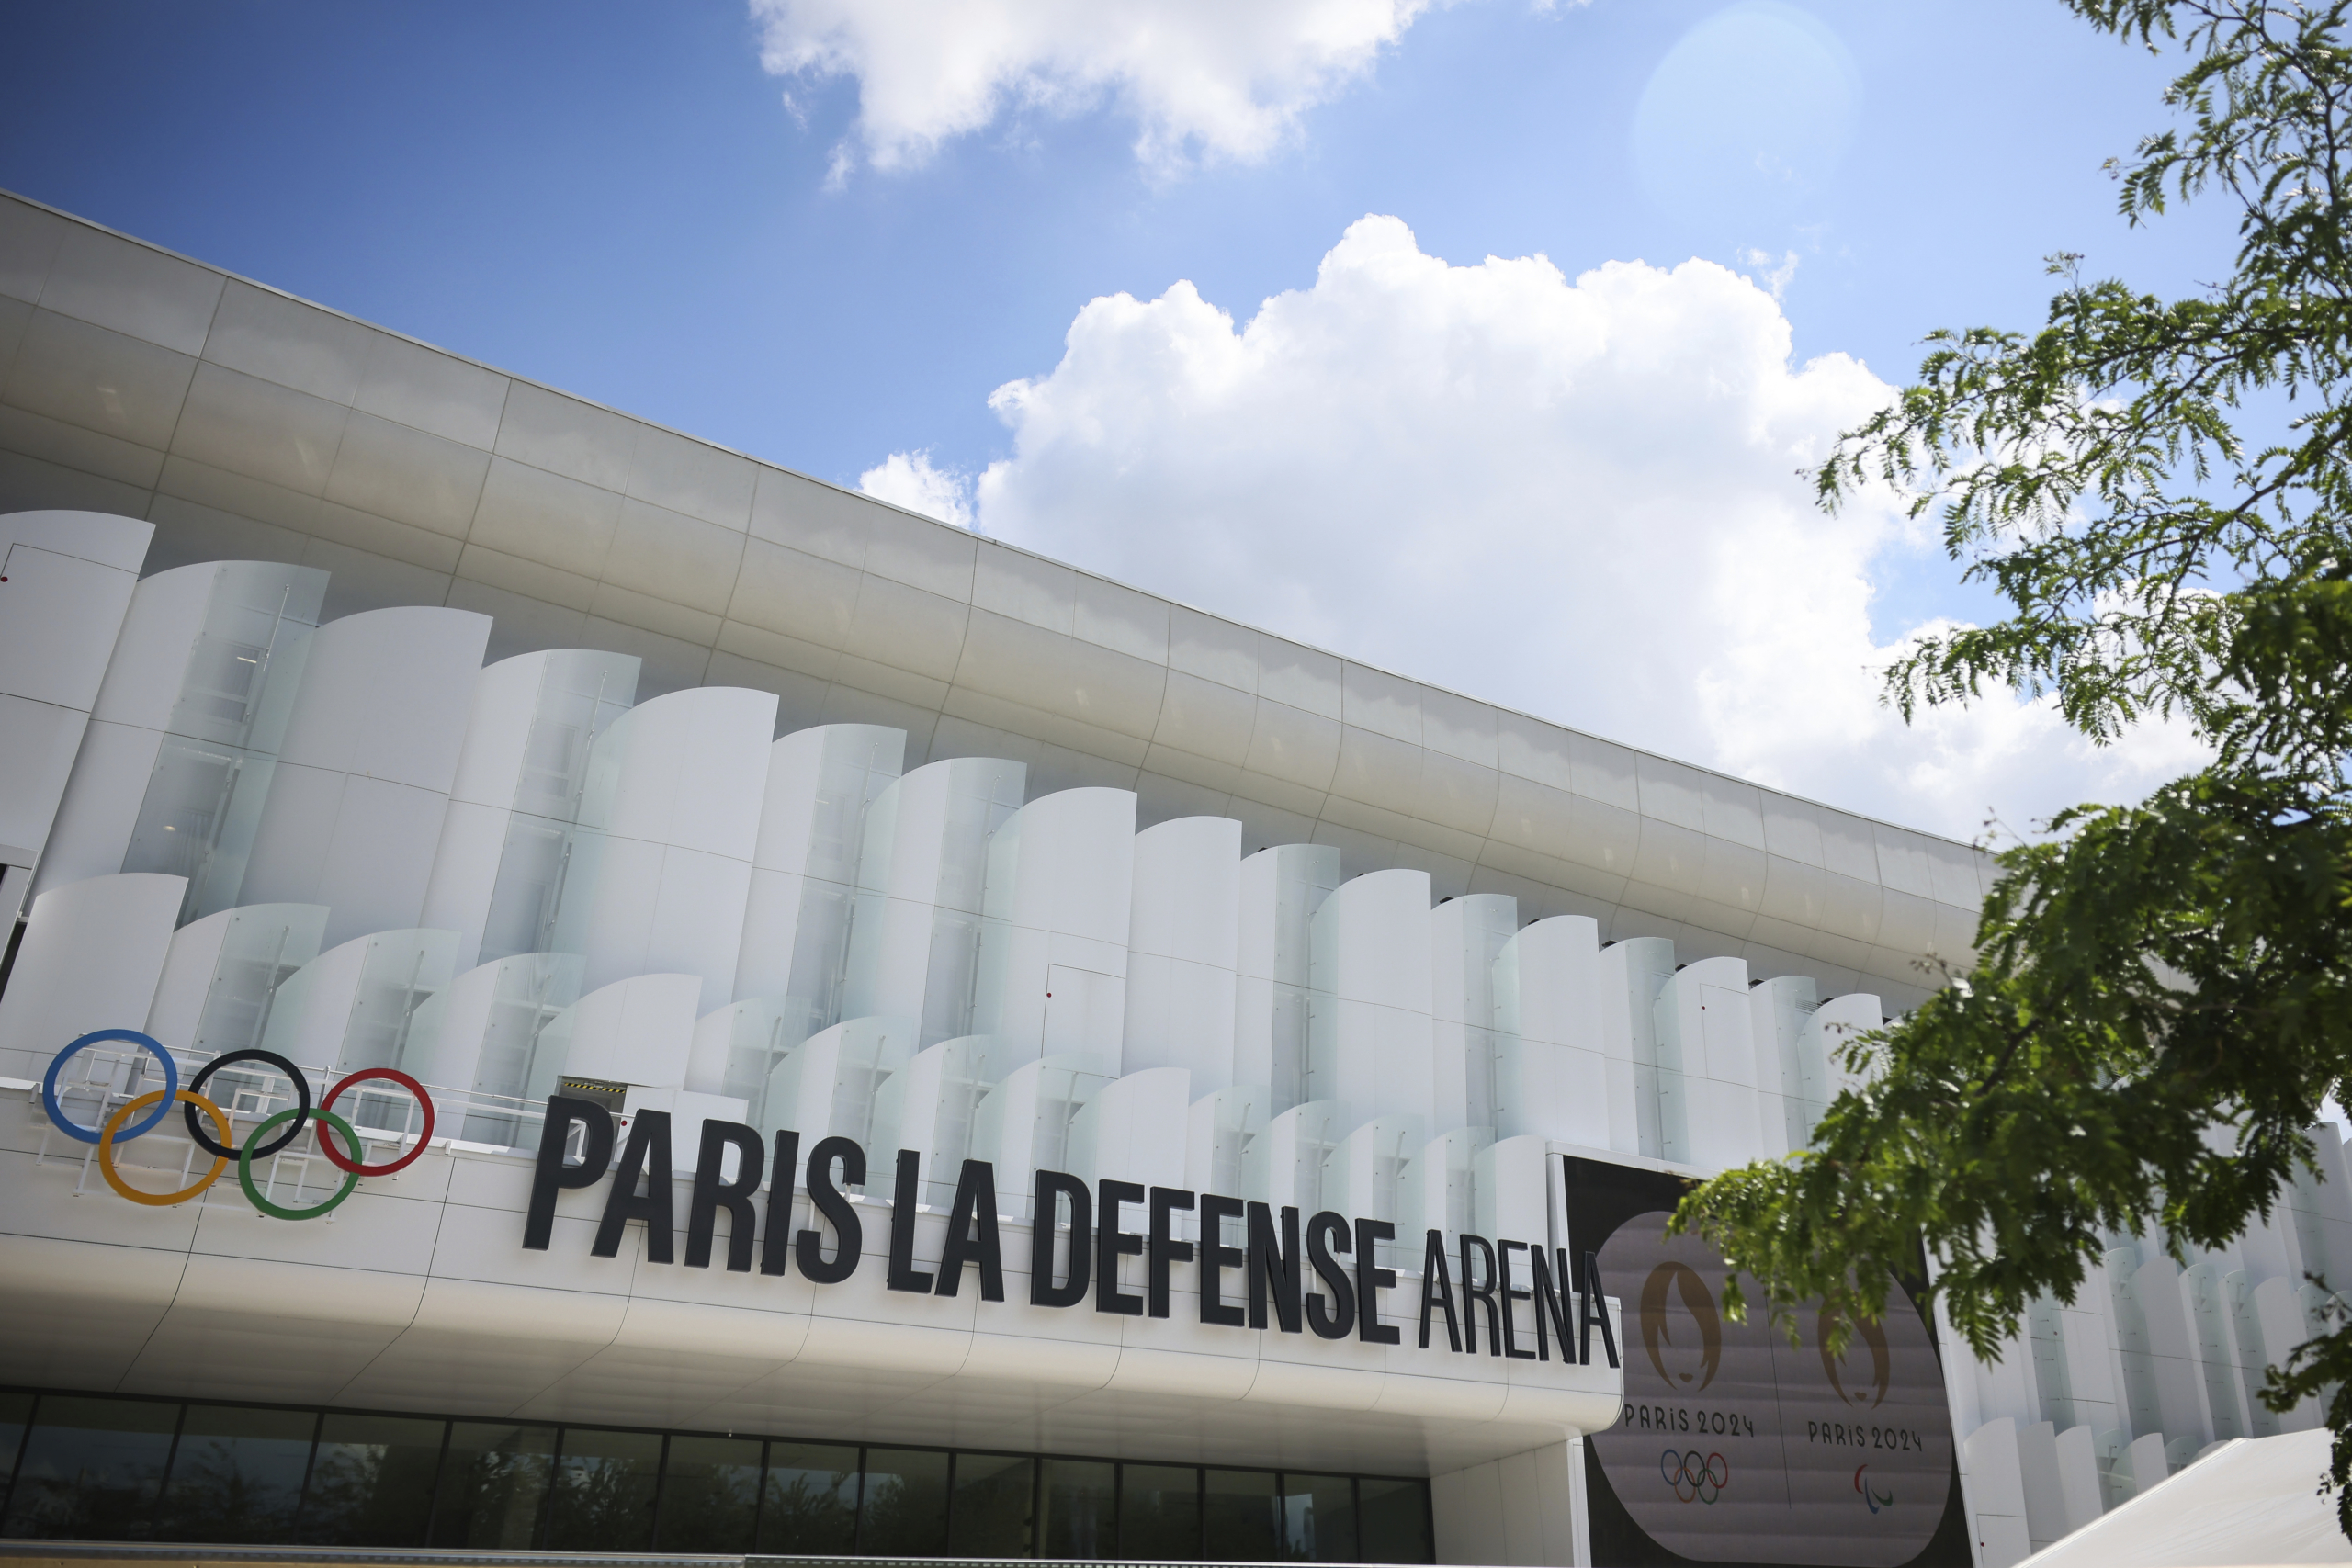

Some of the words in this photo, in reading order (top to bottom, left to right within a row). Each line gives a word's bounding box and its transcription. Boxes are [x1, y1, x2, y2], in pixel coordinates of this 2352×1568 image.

[522, 1094, 866, 1284] PARIS
[887, 1149, 1005, 1303] LA
[1029, 1168, 1401, 1346] DEFENSE
[1418, 1229, 1621, 1370] ARENA
[1697, 1410, 1754, 1438] 2024
[1871, 1426, 1923, 1452] 2024
